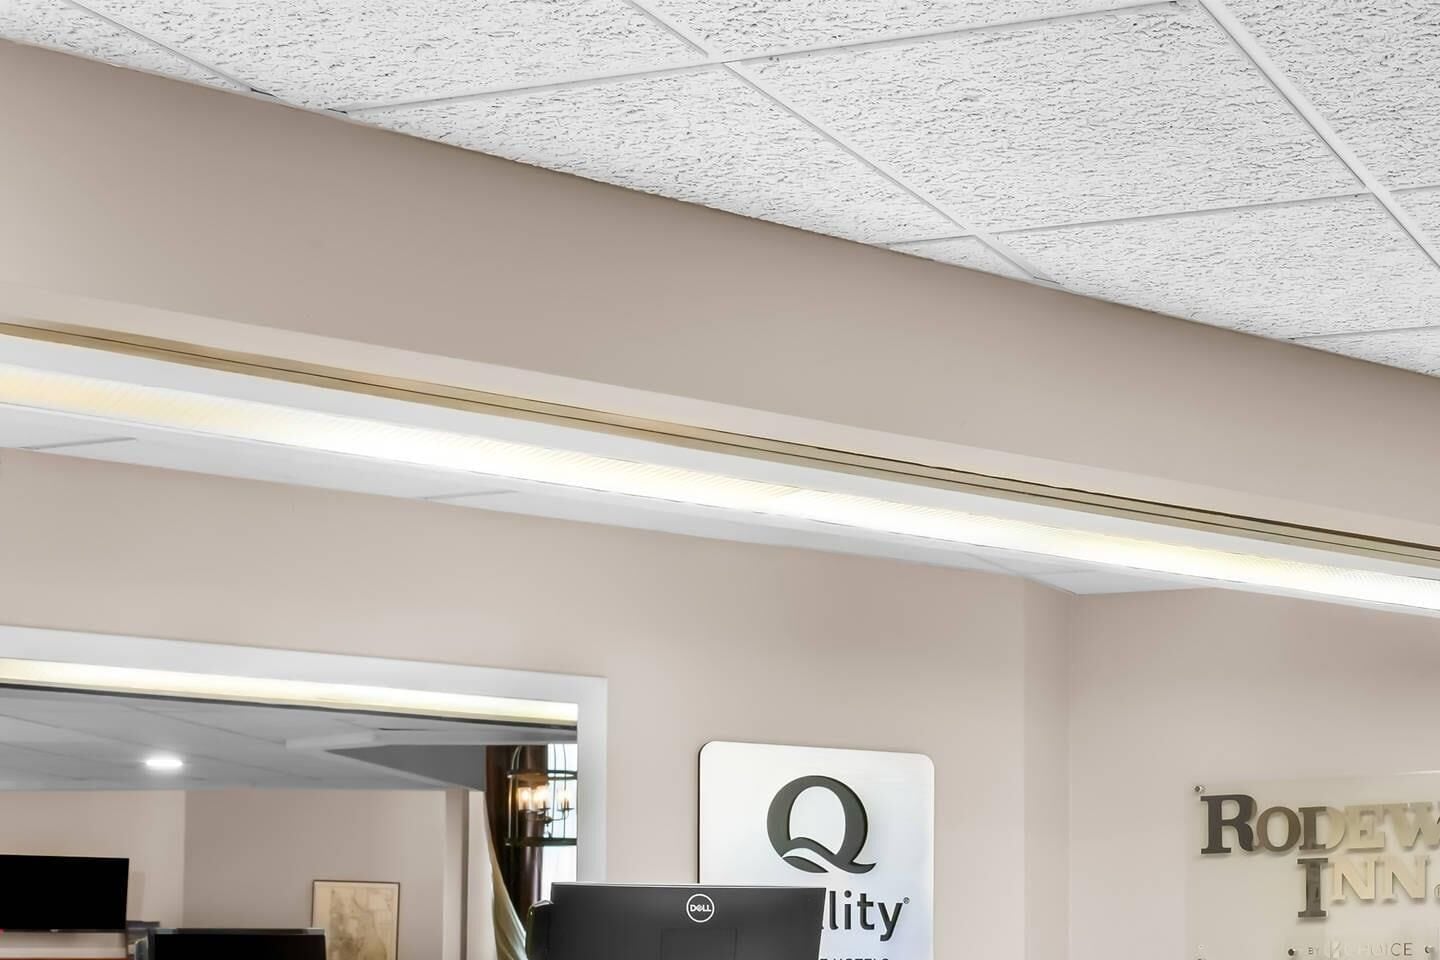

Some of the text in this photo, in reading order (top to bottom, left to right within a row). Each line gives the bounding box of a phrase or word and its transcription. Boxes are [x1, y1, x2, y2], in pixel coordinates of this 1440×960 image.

[766, 775, 877, 875] Q
[690, 904, 712, 912] DELL
[822, 889, 904, 942] lity
[1297, 855, 1430, 918] INN
